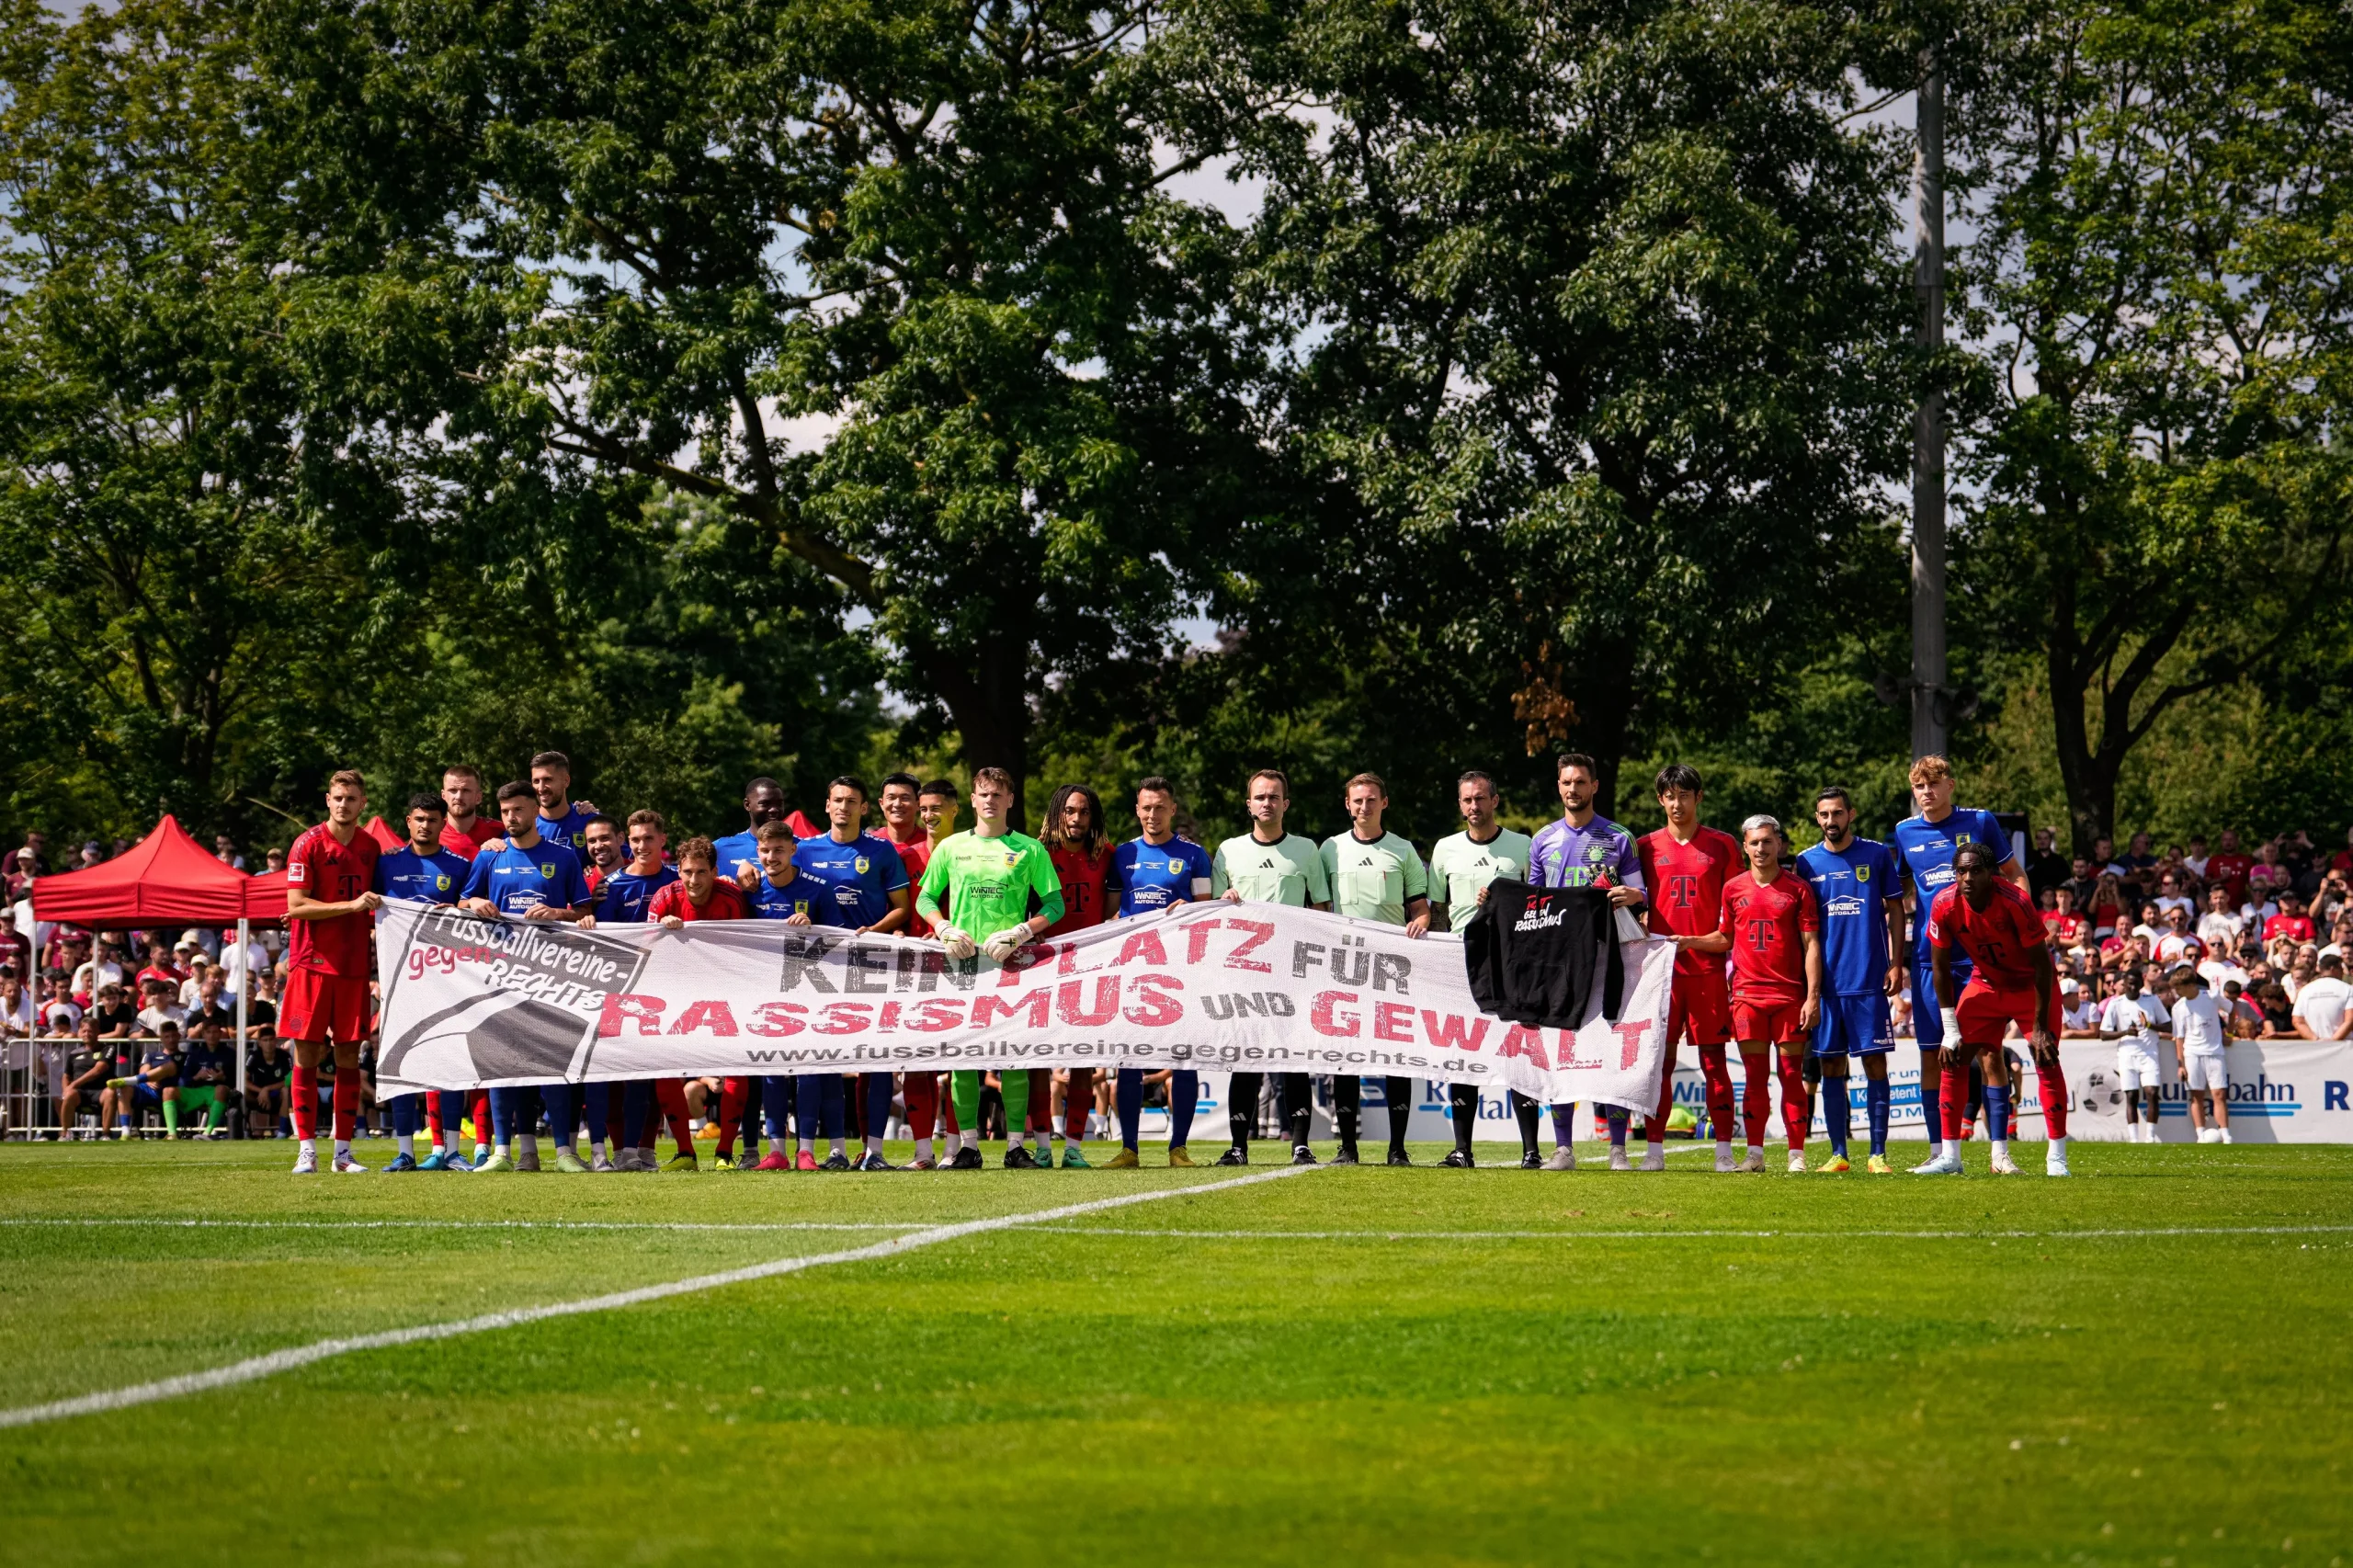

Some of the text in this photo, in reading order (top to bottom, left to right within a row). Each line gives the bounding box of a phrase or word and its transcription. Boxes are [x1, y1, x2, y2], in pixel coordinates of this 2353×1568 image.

[1926, 877, 1957, 887] AUTOGLA
[436, 910, 630, 983] Fussballvereine-
[779, 918, 1411, 996] KEIN PLATZ FÜR
[485, 959, 608, 1012] RECHTS
[598, 972, 1652, 1072] RASSISMUS UND GEWALT
[745, 1040, 1489, 1074] www.fussballvereine-gegen-rechts.de
